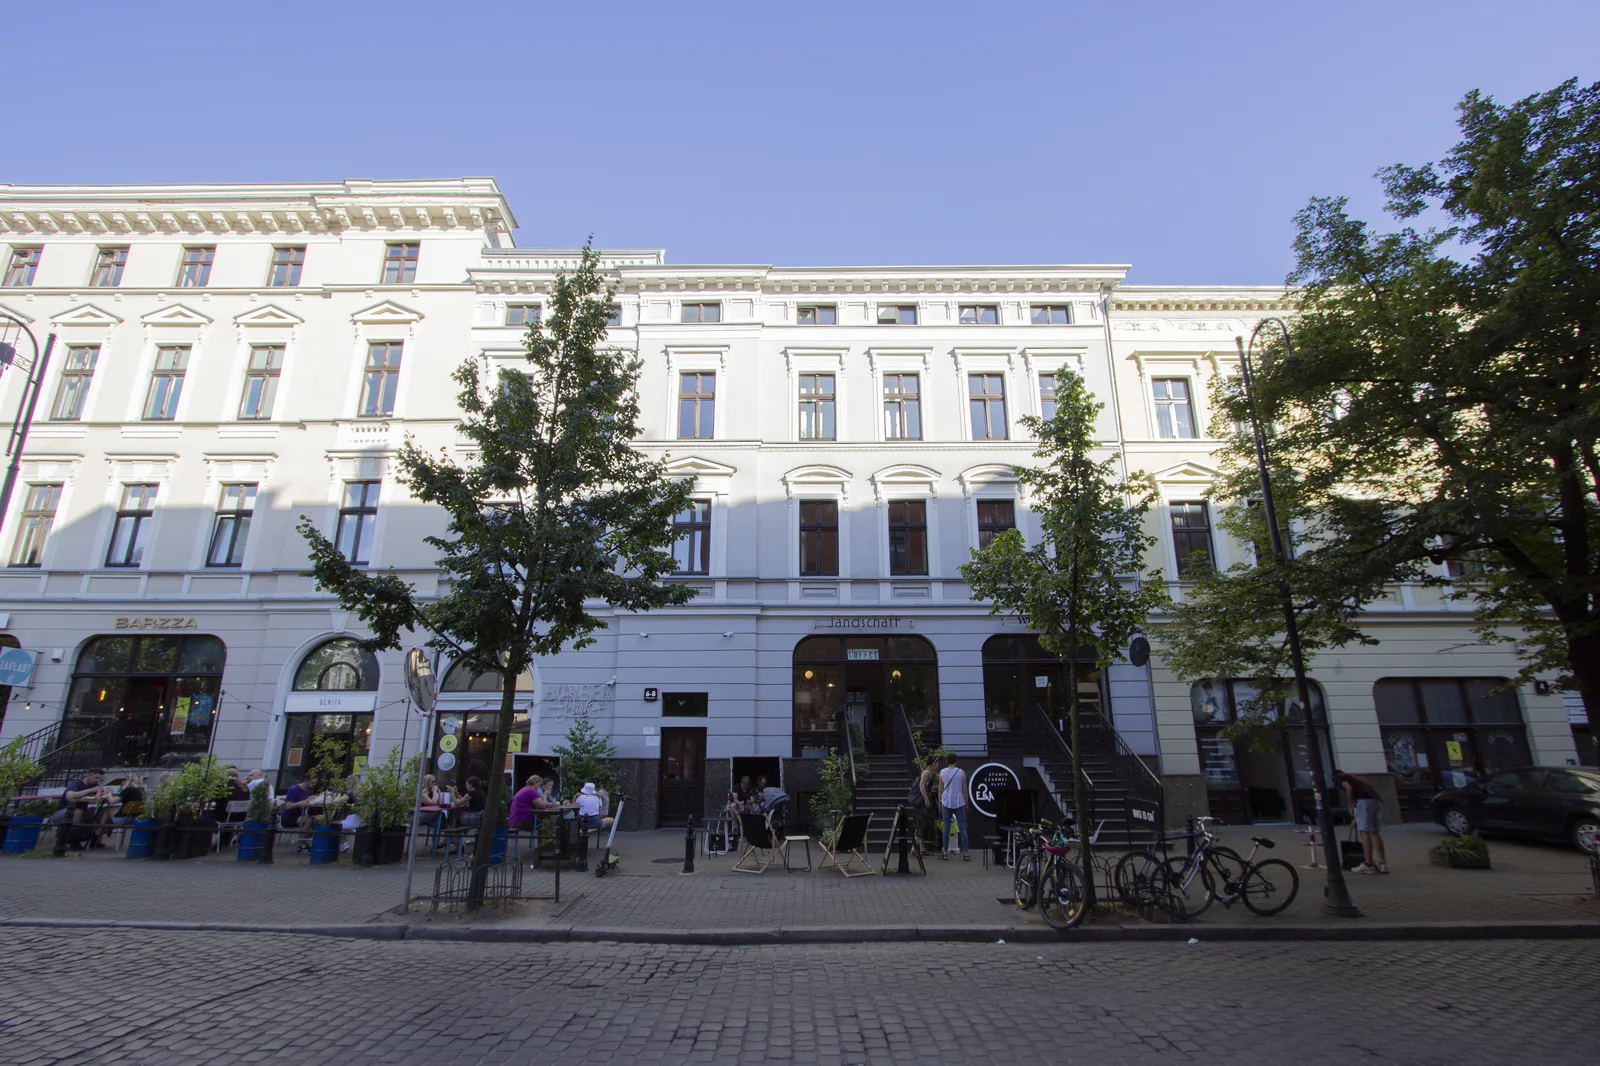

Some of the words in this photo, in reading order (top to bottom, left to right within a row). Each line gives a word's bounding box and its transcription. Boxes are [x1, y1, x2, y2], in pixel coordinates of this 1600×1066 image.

[115, 617, 197, 629] BARZZA
[546, 683, 611, 700] BURGER
[319, 698, 341, 706] BENITA
